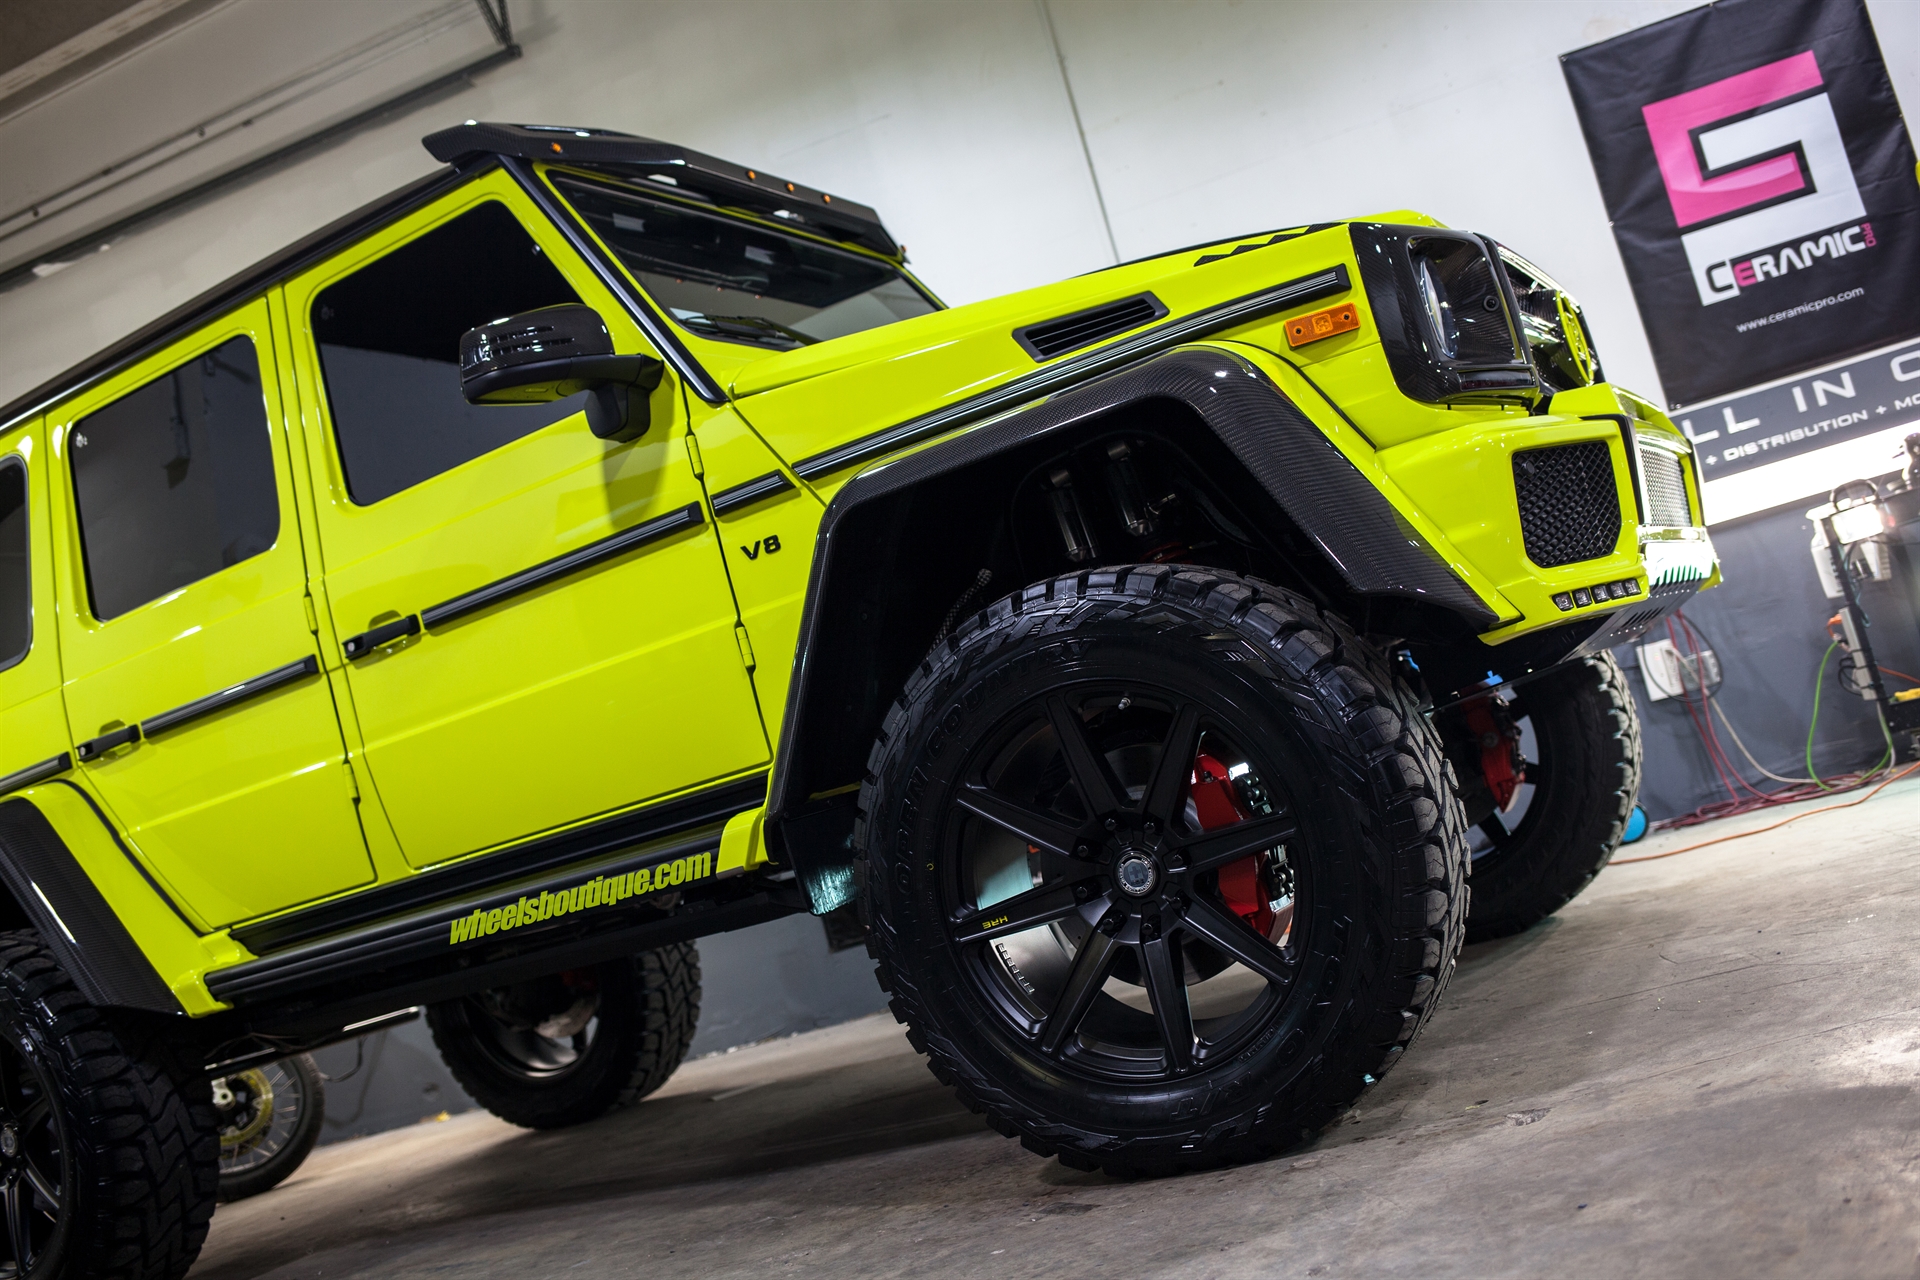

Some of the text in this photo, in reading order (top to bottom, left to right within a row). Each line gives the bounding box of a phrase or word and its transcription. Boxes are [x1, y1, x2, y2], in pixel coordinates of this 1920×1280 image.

[1860, 222, 1877, 248] PRO
[1705, 224, 1867, 294] CERAMIC
[1735, 287, 1865, 333] www.ceramicpro.com
[1791, 371, 1857, 413] IN
[1722, 409, 1869, 462] DISTRIBUTION
[740, 534, 781, 561] V8
[449, 851, 712, 945] wheelsboutique.com
[982, 915, 1009, 930] HRE
